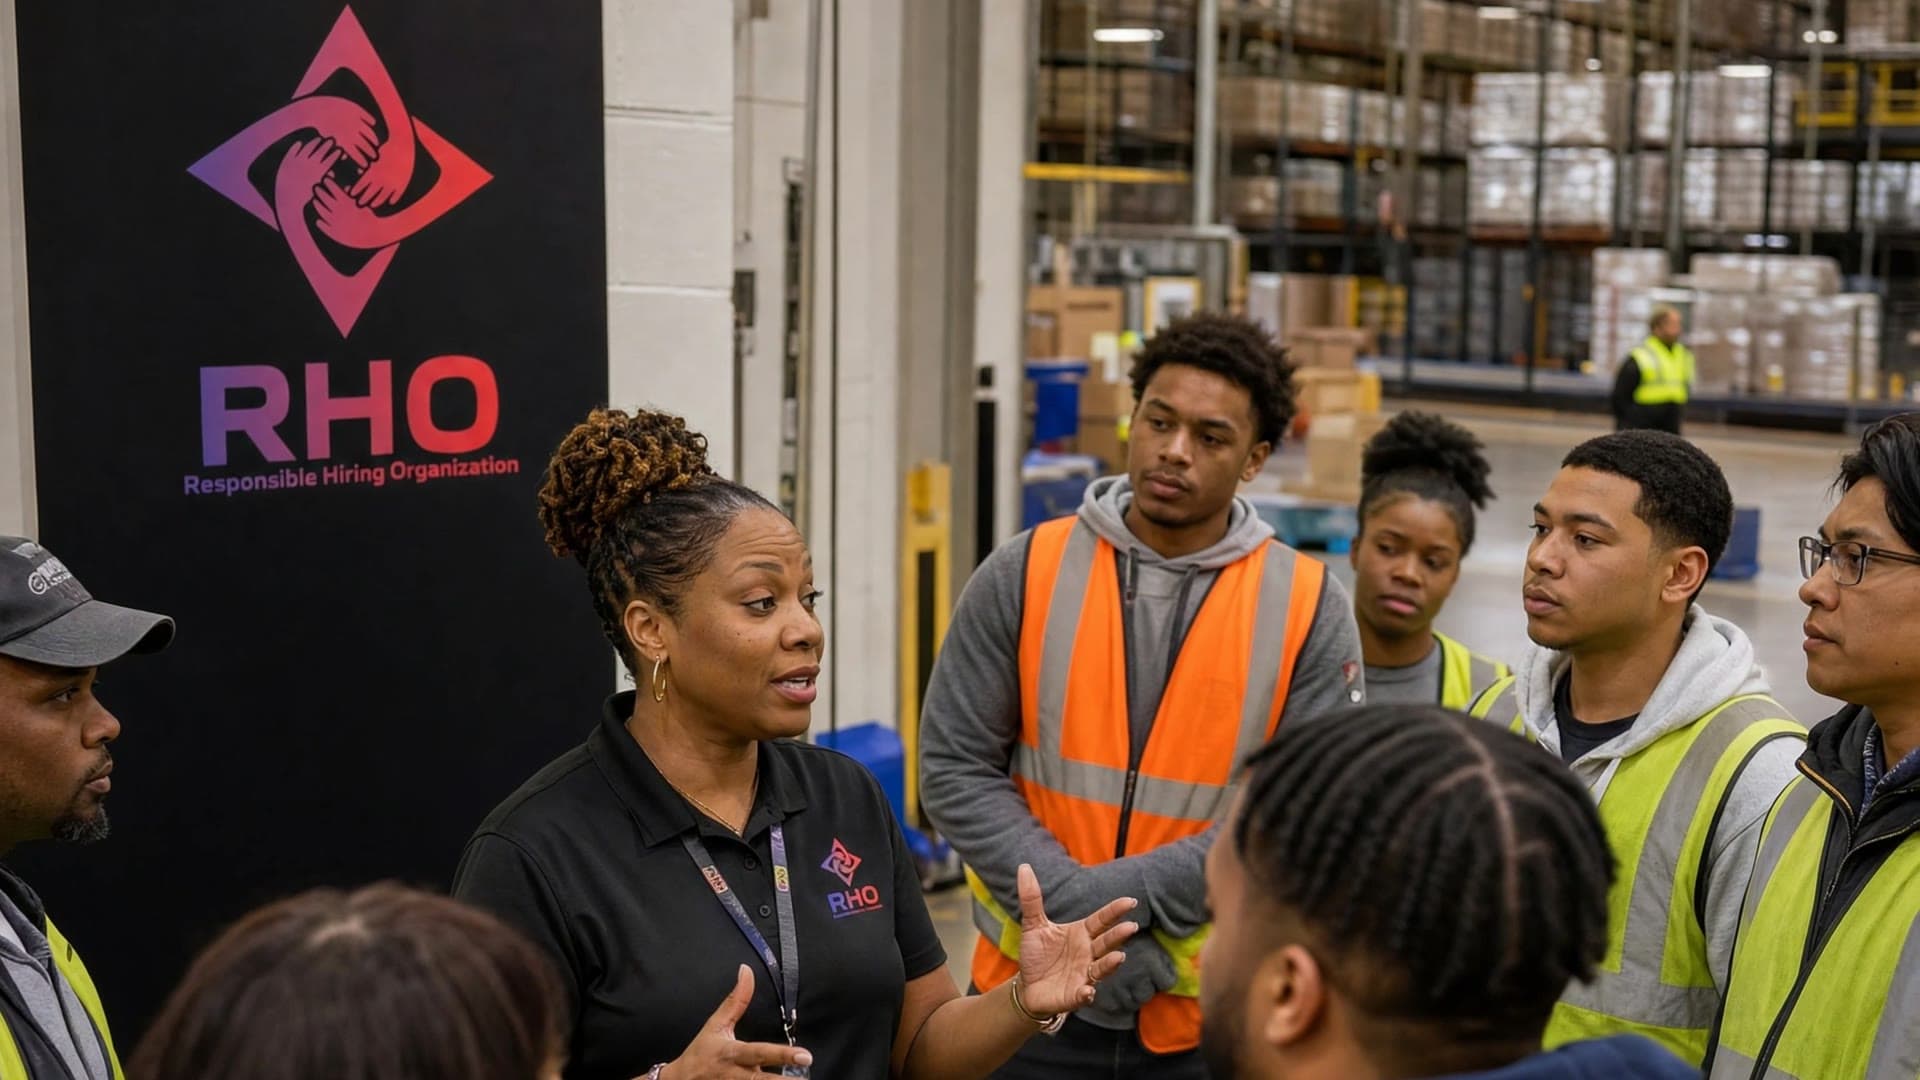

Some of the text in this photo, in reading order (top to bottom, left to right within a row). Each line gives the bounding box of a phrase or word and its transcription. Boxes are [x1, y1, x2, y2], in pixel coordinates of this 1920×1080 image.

[199, 354, 500, 468] RHO
[183, 456, 520, 497] Responsible Hiring Organization
[827, 885, 880, 913] RHO
